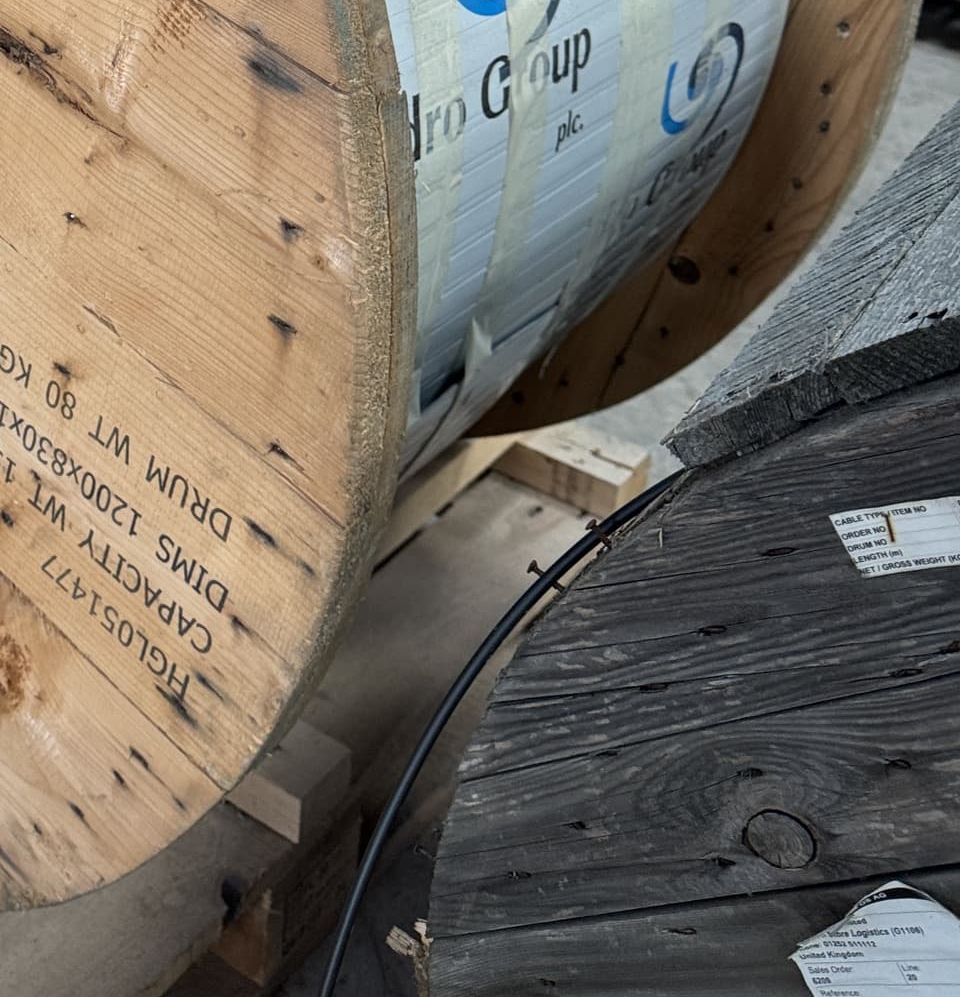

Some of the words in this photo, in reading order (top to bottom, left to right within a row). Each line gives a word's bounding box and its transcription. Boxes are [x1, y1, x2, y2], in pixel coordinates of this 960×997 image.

[555, 110, 584, 153] plc.
[46, 380, 77, 420] 80
[88, 415, 130, 466] WT
[27, 481, 65, 532] WT
[145, 455, 233, 542] DRUM
[834, 514, 864, 526] CABLE
[864, 510, 886, 521] TYPE
[892, 507, 912, 517] ITEM
[913, 505, 927, 513] NO
[841, 527, 872, 540] ORDER
[872, 525, 886, 534] NO
[847, 540, 873, 552] DRUM
[873, 538, 888, 546] NO
[854, 551, 889, 564] LENGTH
[889, 549, 903, 558] (m)
[882, 560, 912, 571] GROSS
[913, 555, 946, 567] WEIGHT
[155, 534, 229, 613] DIMS
[78, 529, 213, 654] CAPACITY
[41, 555, 190, 702] HGL051477
[850, 928, 889, 938] Logistics
[808, 966, 830, 974] Sales
[827, 951, 864, 960] Kingdom
